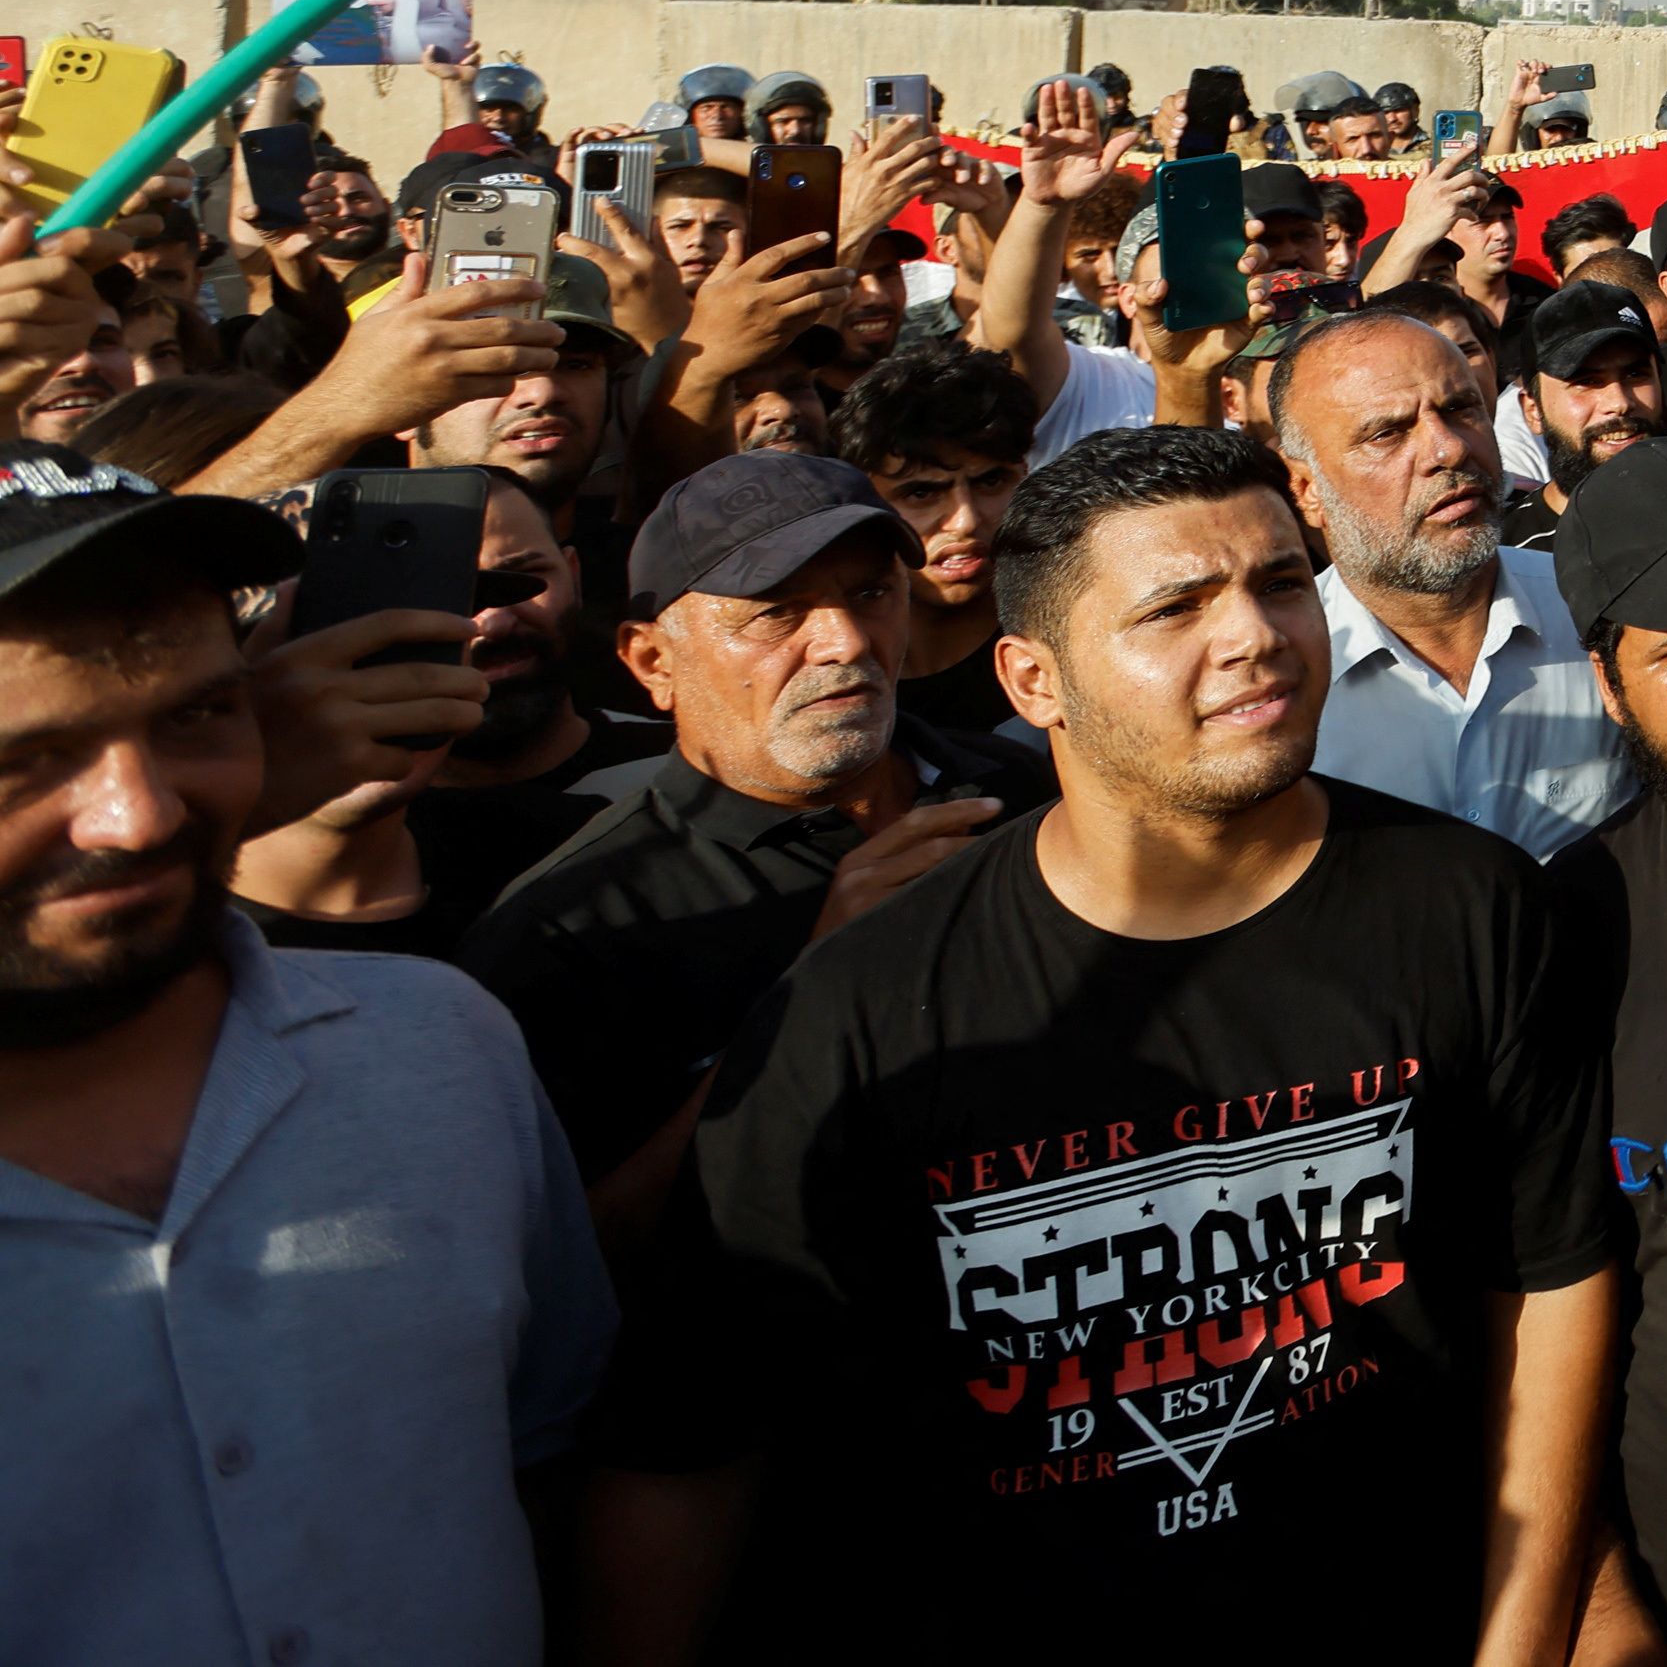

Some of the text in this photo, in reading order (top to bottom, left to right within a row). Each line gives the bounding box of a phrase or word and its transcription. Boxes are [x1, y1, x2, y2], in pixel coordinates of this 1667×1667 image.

[926, 1058, 1420, 1200] NEVER GIVE UP
[985, 1317, 1098, 1363] NEW
[1047, 1332, 1332, 1453] 19 EST 87
[1157, 1481, 1239, 1537] USA
